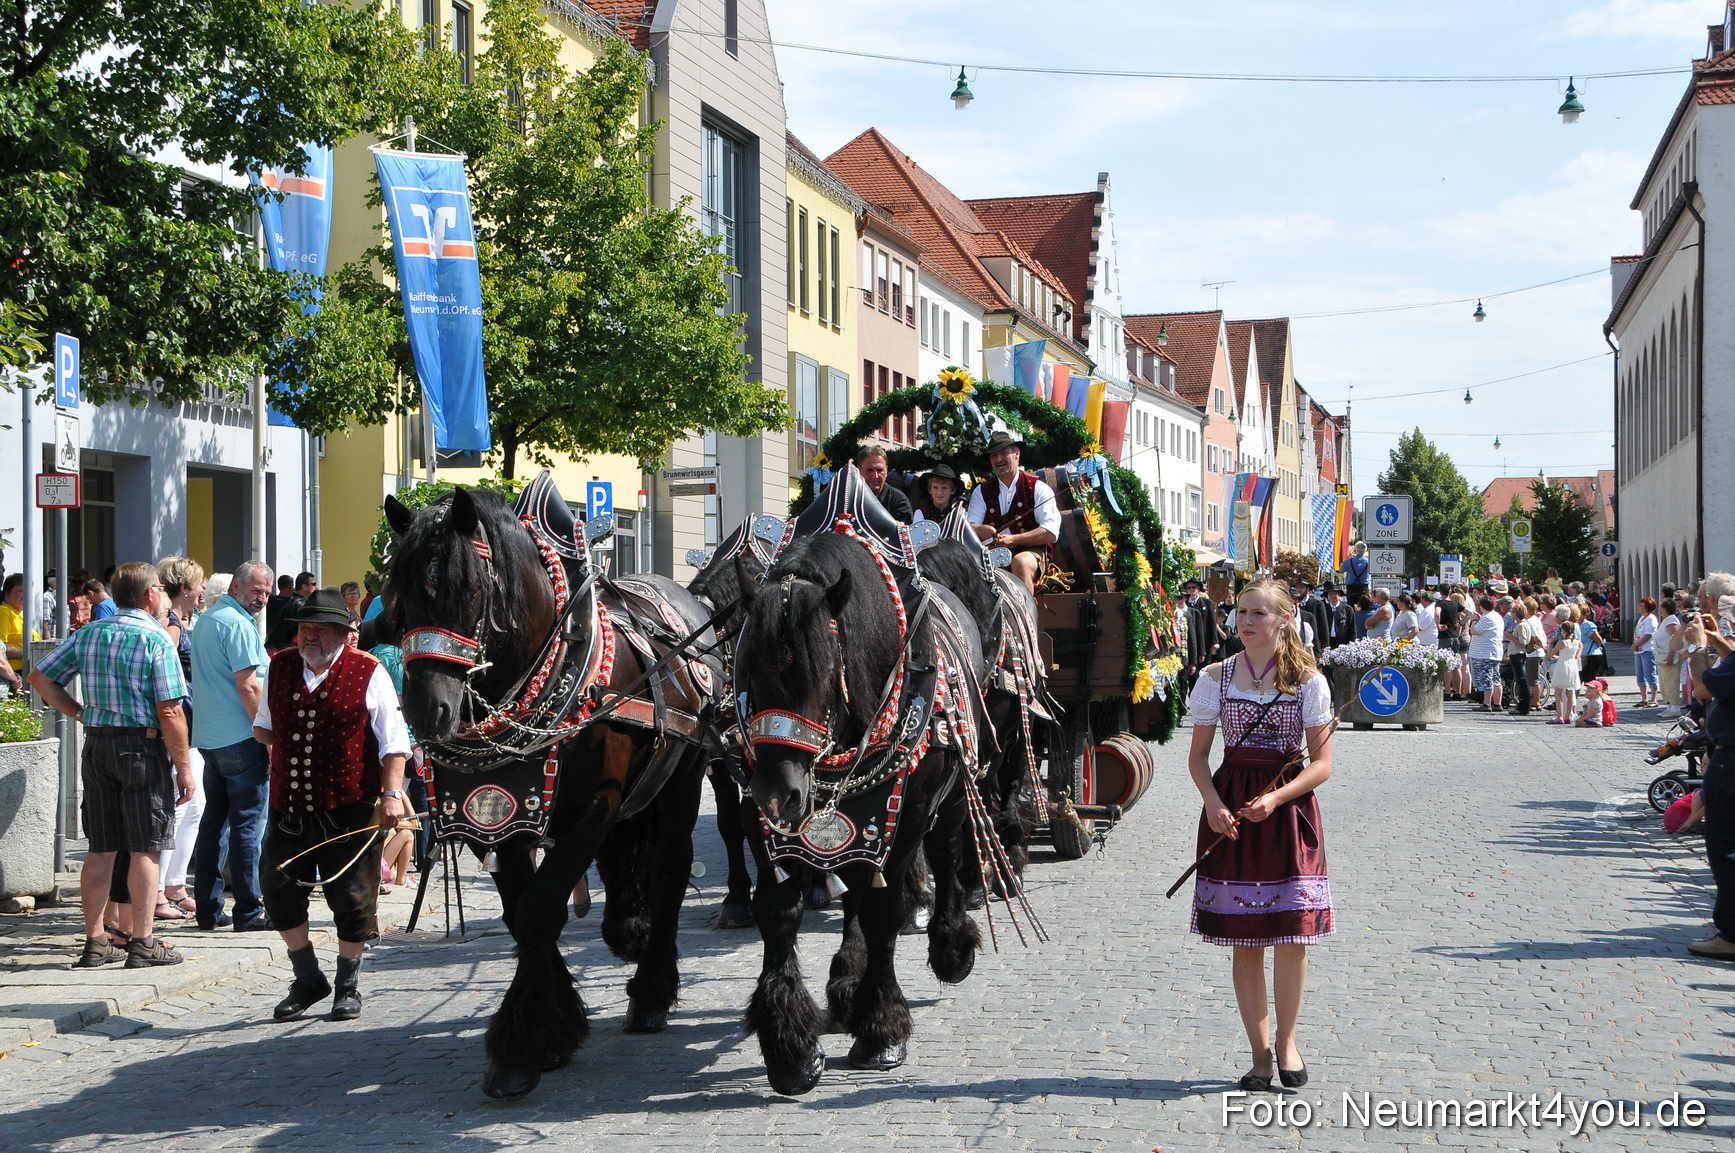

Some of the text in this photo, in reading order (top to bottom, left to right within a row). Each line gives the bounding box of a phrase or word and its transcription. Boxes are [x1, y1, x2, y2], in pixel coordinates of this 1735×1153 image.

[301, 253, 318, 264] eG
[472, 306, 482, 316] eG
[61, 344, 75, 398] P
[662, 469, 715, 479] Brunnwirtsgasse
[46, 477, 68, 485] H150
[592, 486, 608, 519] P
[1375, 529, 1398, 538] ZONE
